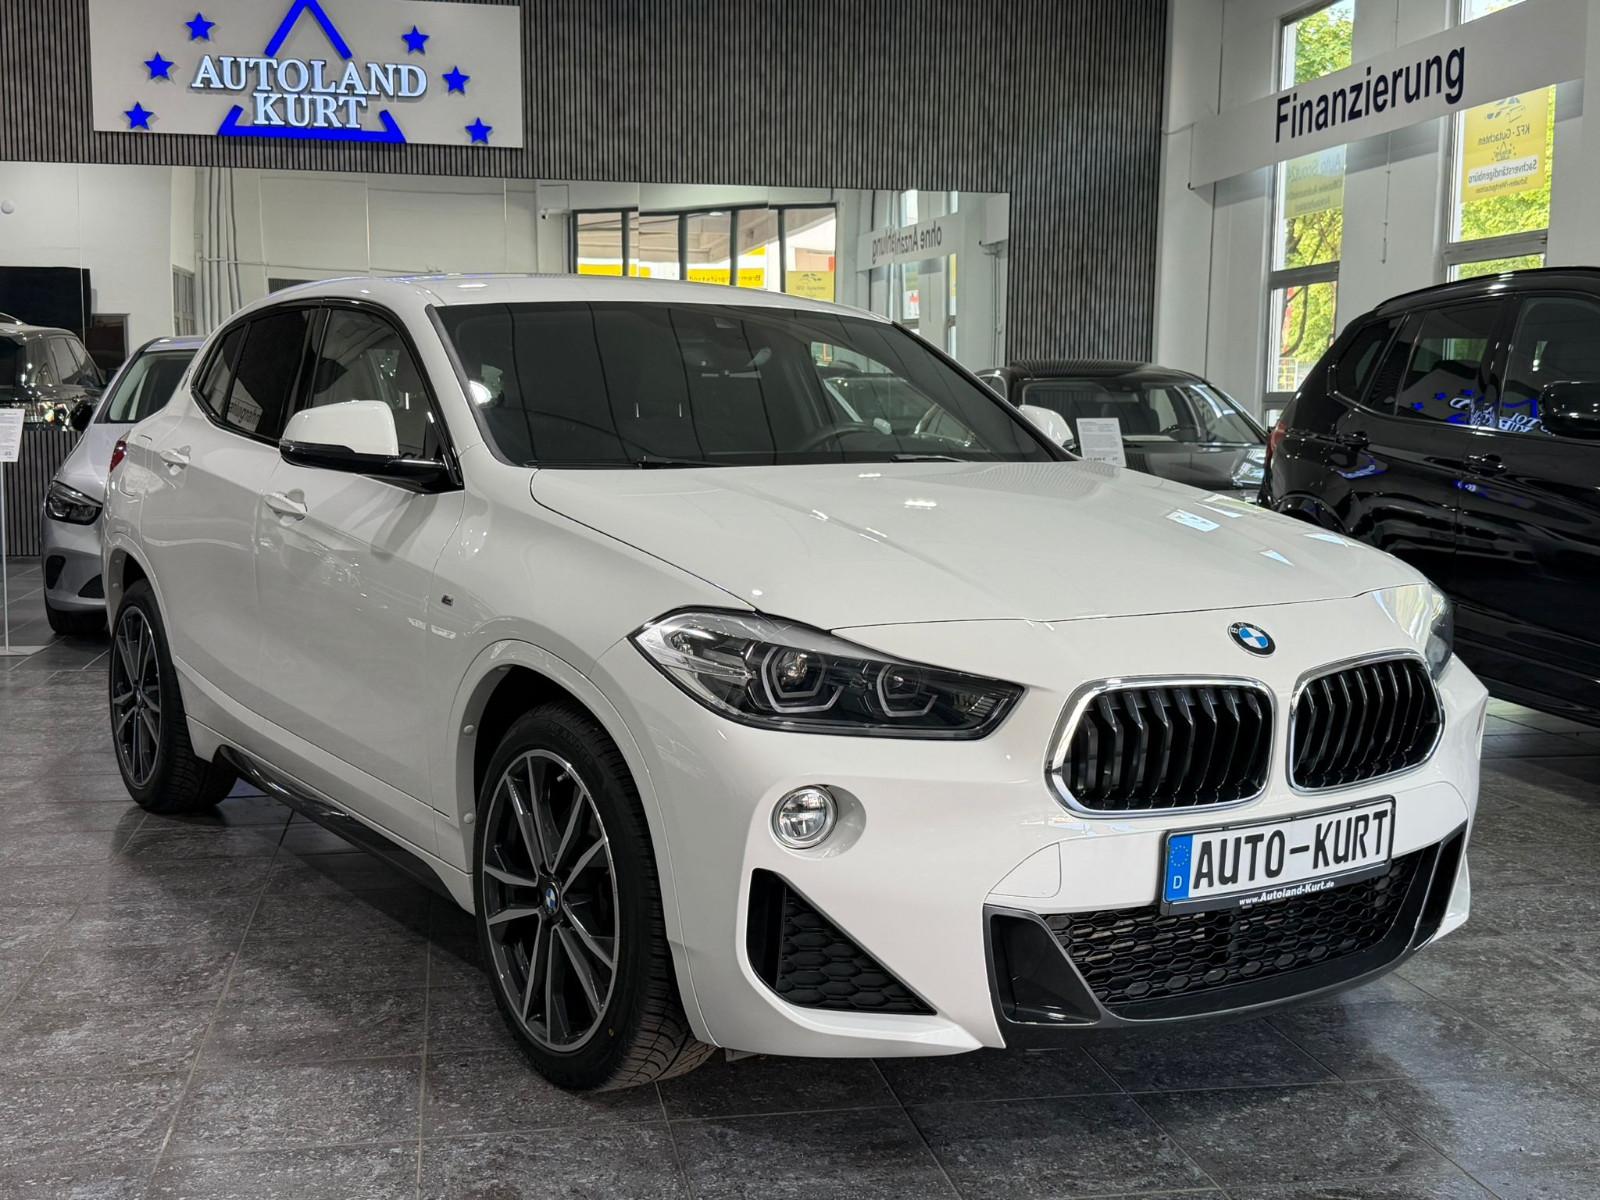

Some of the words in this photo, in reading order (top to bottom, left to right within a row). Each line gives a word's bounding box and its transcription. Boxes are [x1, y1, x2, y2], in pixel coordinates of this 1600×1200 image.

[191, 54, 428, 98] AUTOLAND
[252, 92, 368, 129] KURT
[1274, 46, 1465, 144] Finanzierung
[1172, 875, 1183, 890] D
[1239, 880, 1336, 906] www.Autoland-Kurt.de
